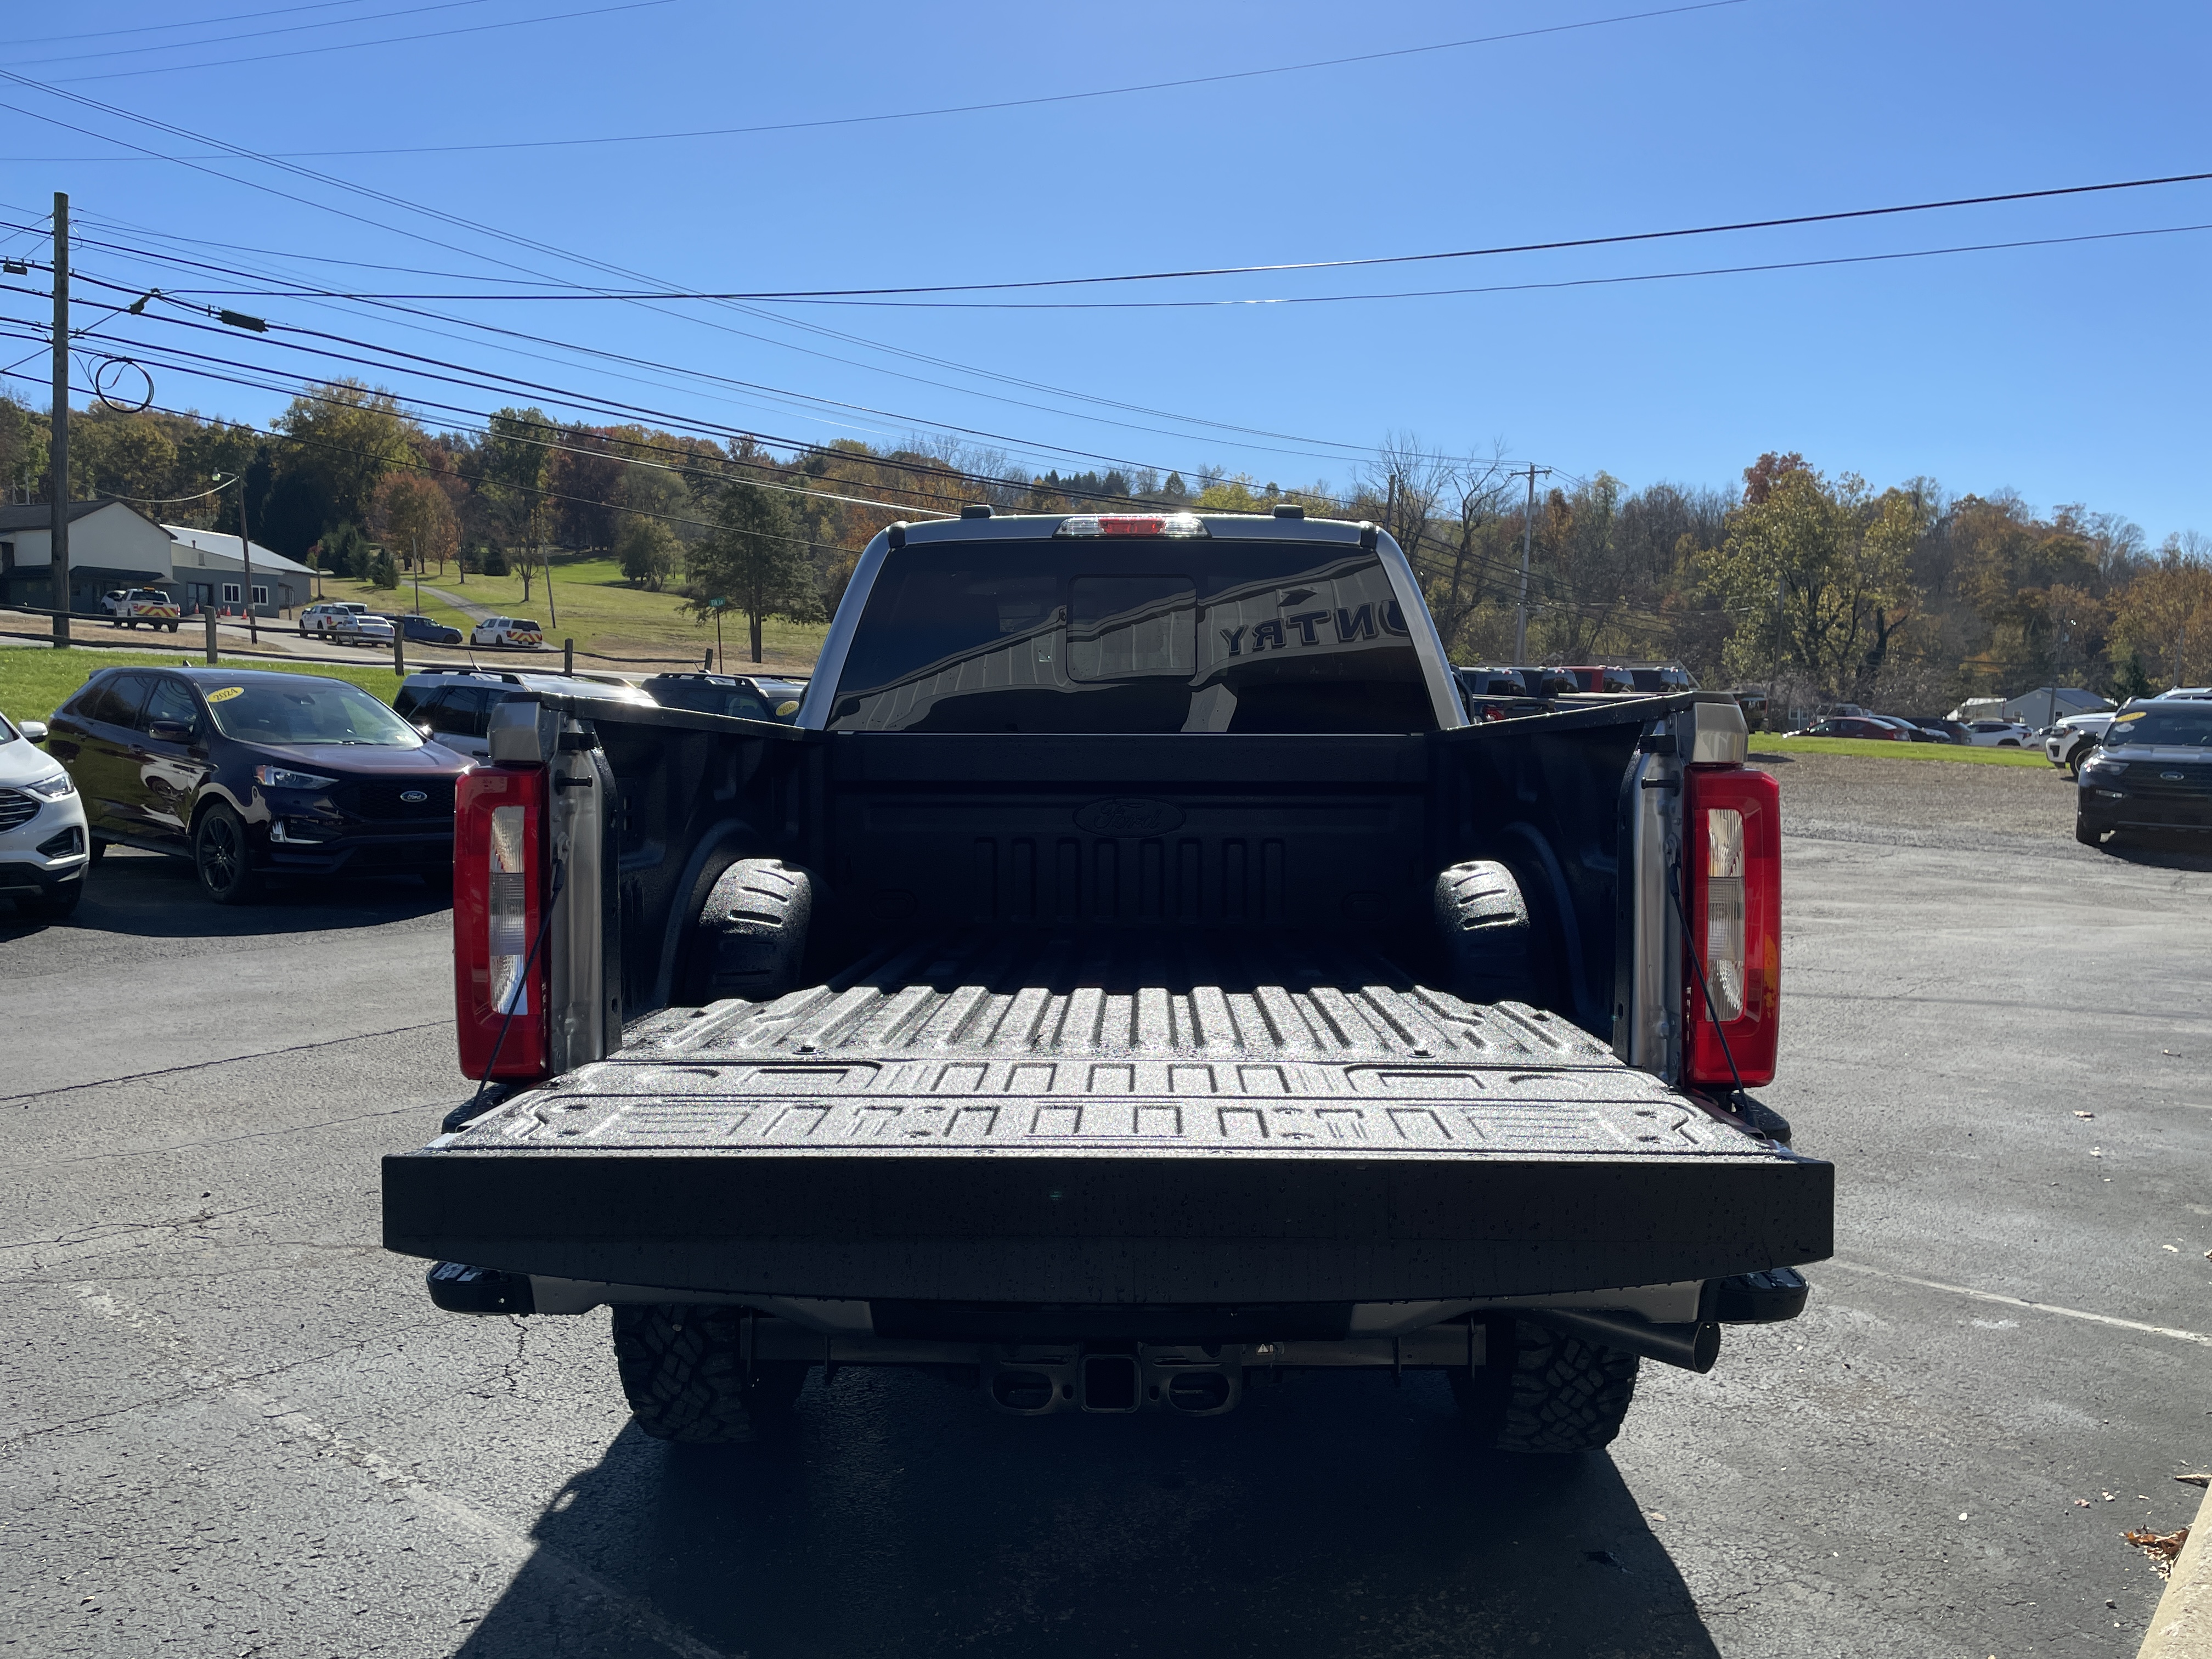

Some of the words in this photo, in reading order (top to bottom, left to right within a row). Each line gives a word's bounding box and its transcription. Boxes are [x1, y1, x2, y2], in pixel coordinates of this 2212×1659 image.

[213, 688, 238, 701] 2024
[780, 702, 795, 714] 2025
[1094, 802, 1163, 830] Ford
